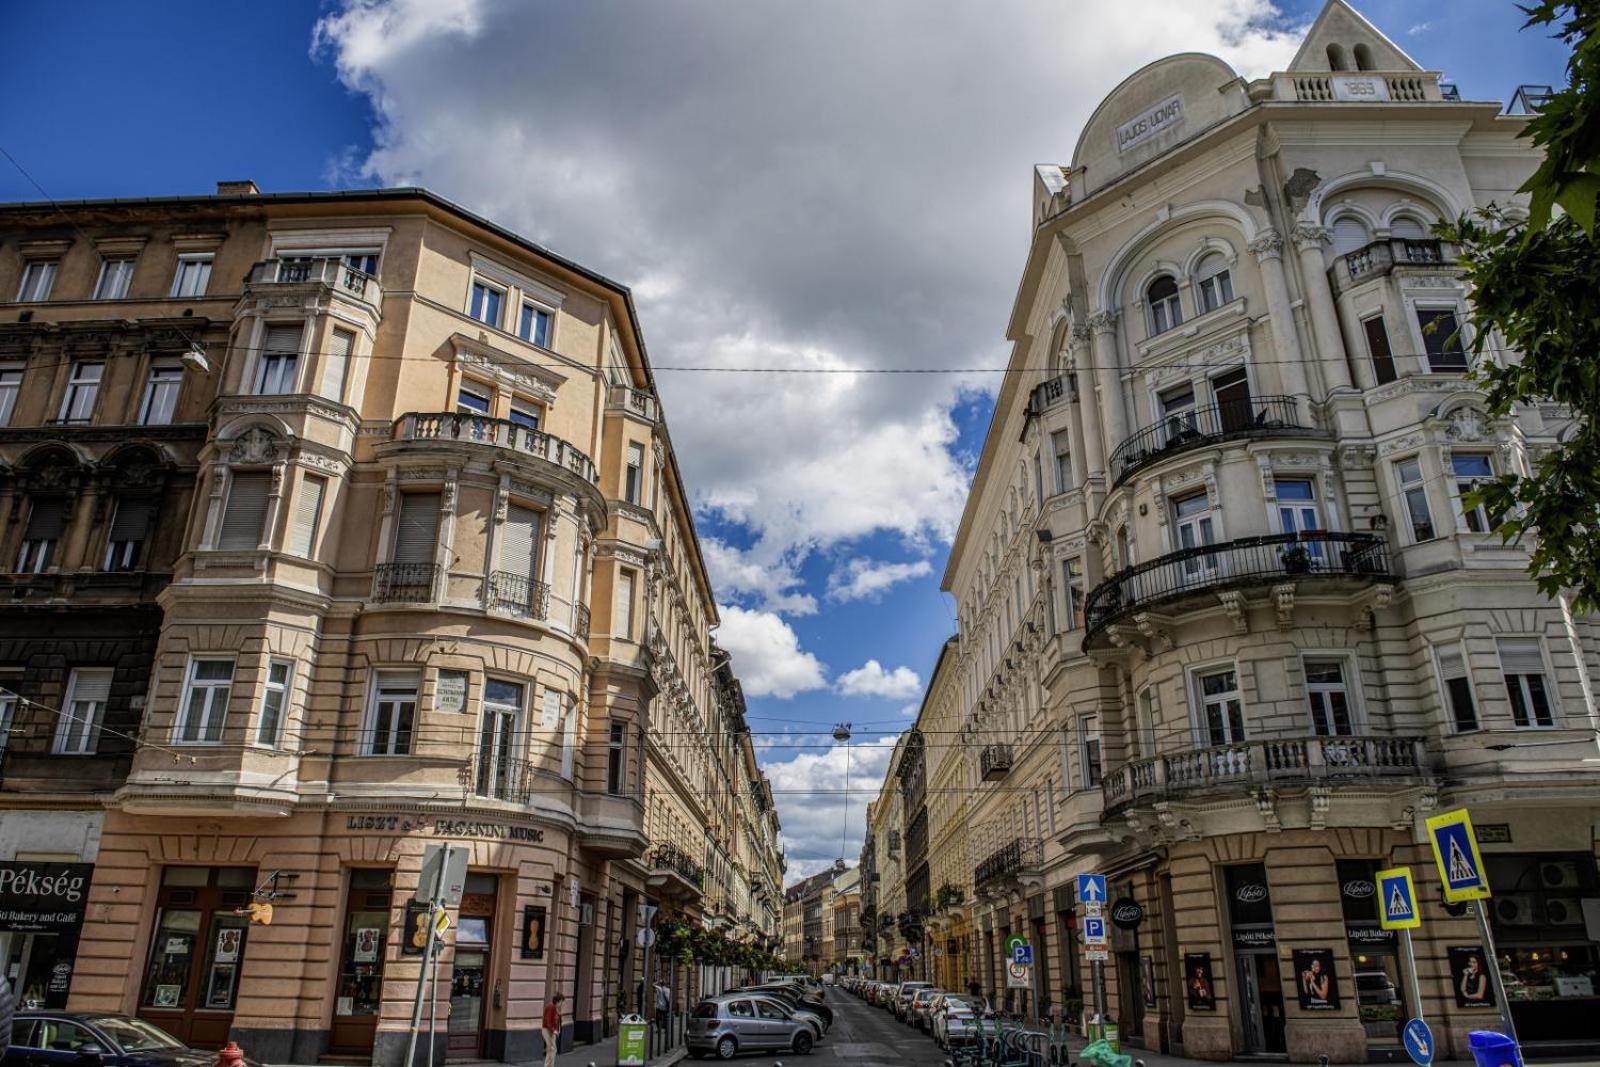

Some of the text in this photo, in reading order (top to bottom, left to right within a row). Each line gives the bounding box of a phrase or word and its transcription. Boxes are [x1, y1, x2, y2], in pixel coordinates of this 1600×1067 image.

[1119, 99, 1181, 145] LAJOS UDVAR
[346, 815, 398, 830] LISZT
[433, 819, 506, 838] PAGANINI
[509, 825, 544, 842] MUSIC
[0, 868, 85, 902] Pékség
[8, 911, 39, 922] Bakery
[39, 912, 56, 922] and
[57, 912, 76, 922] Café
[1090, 921, 1100, 935] P
[1015, 947, 1025, 962] P
